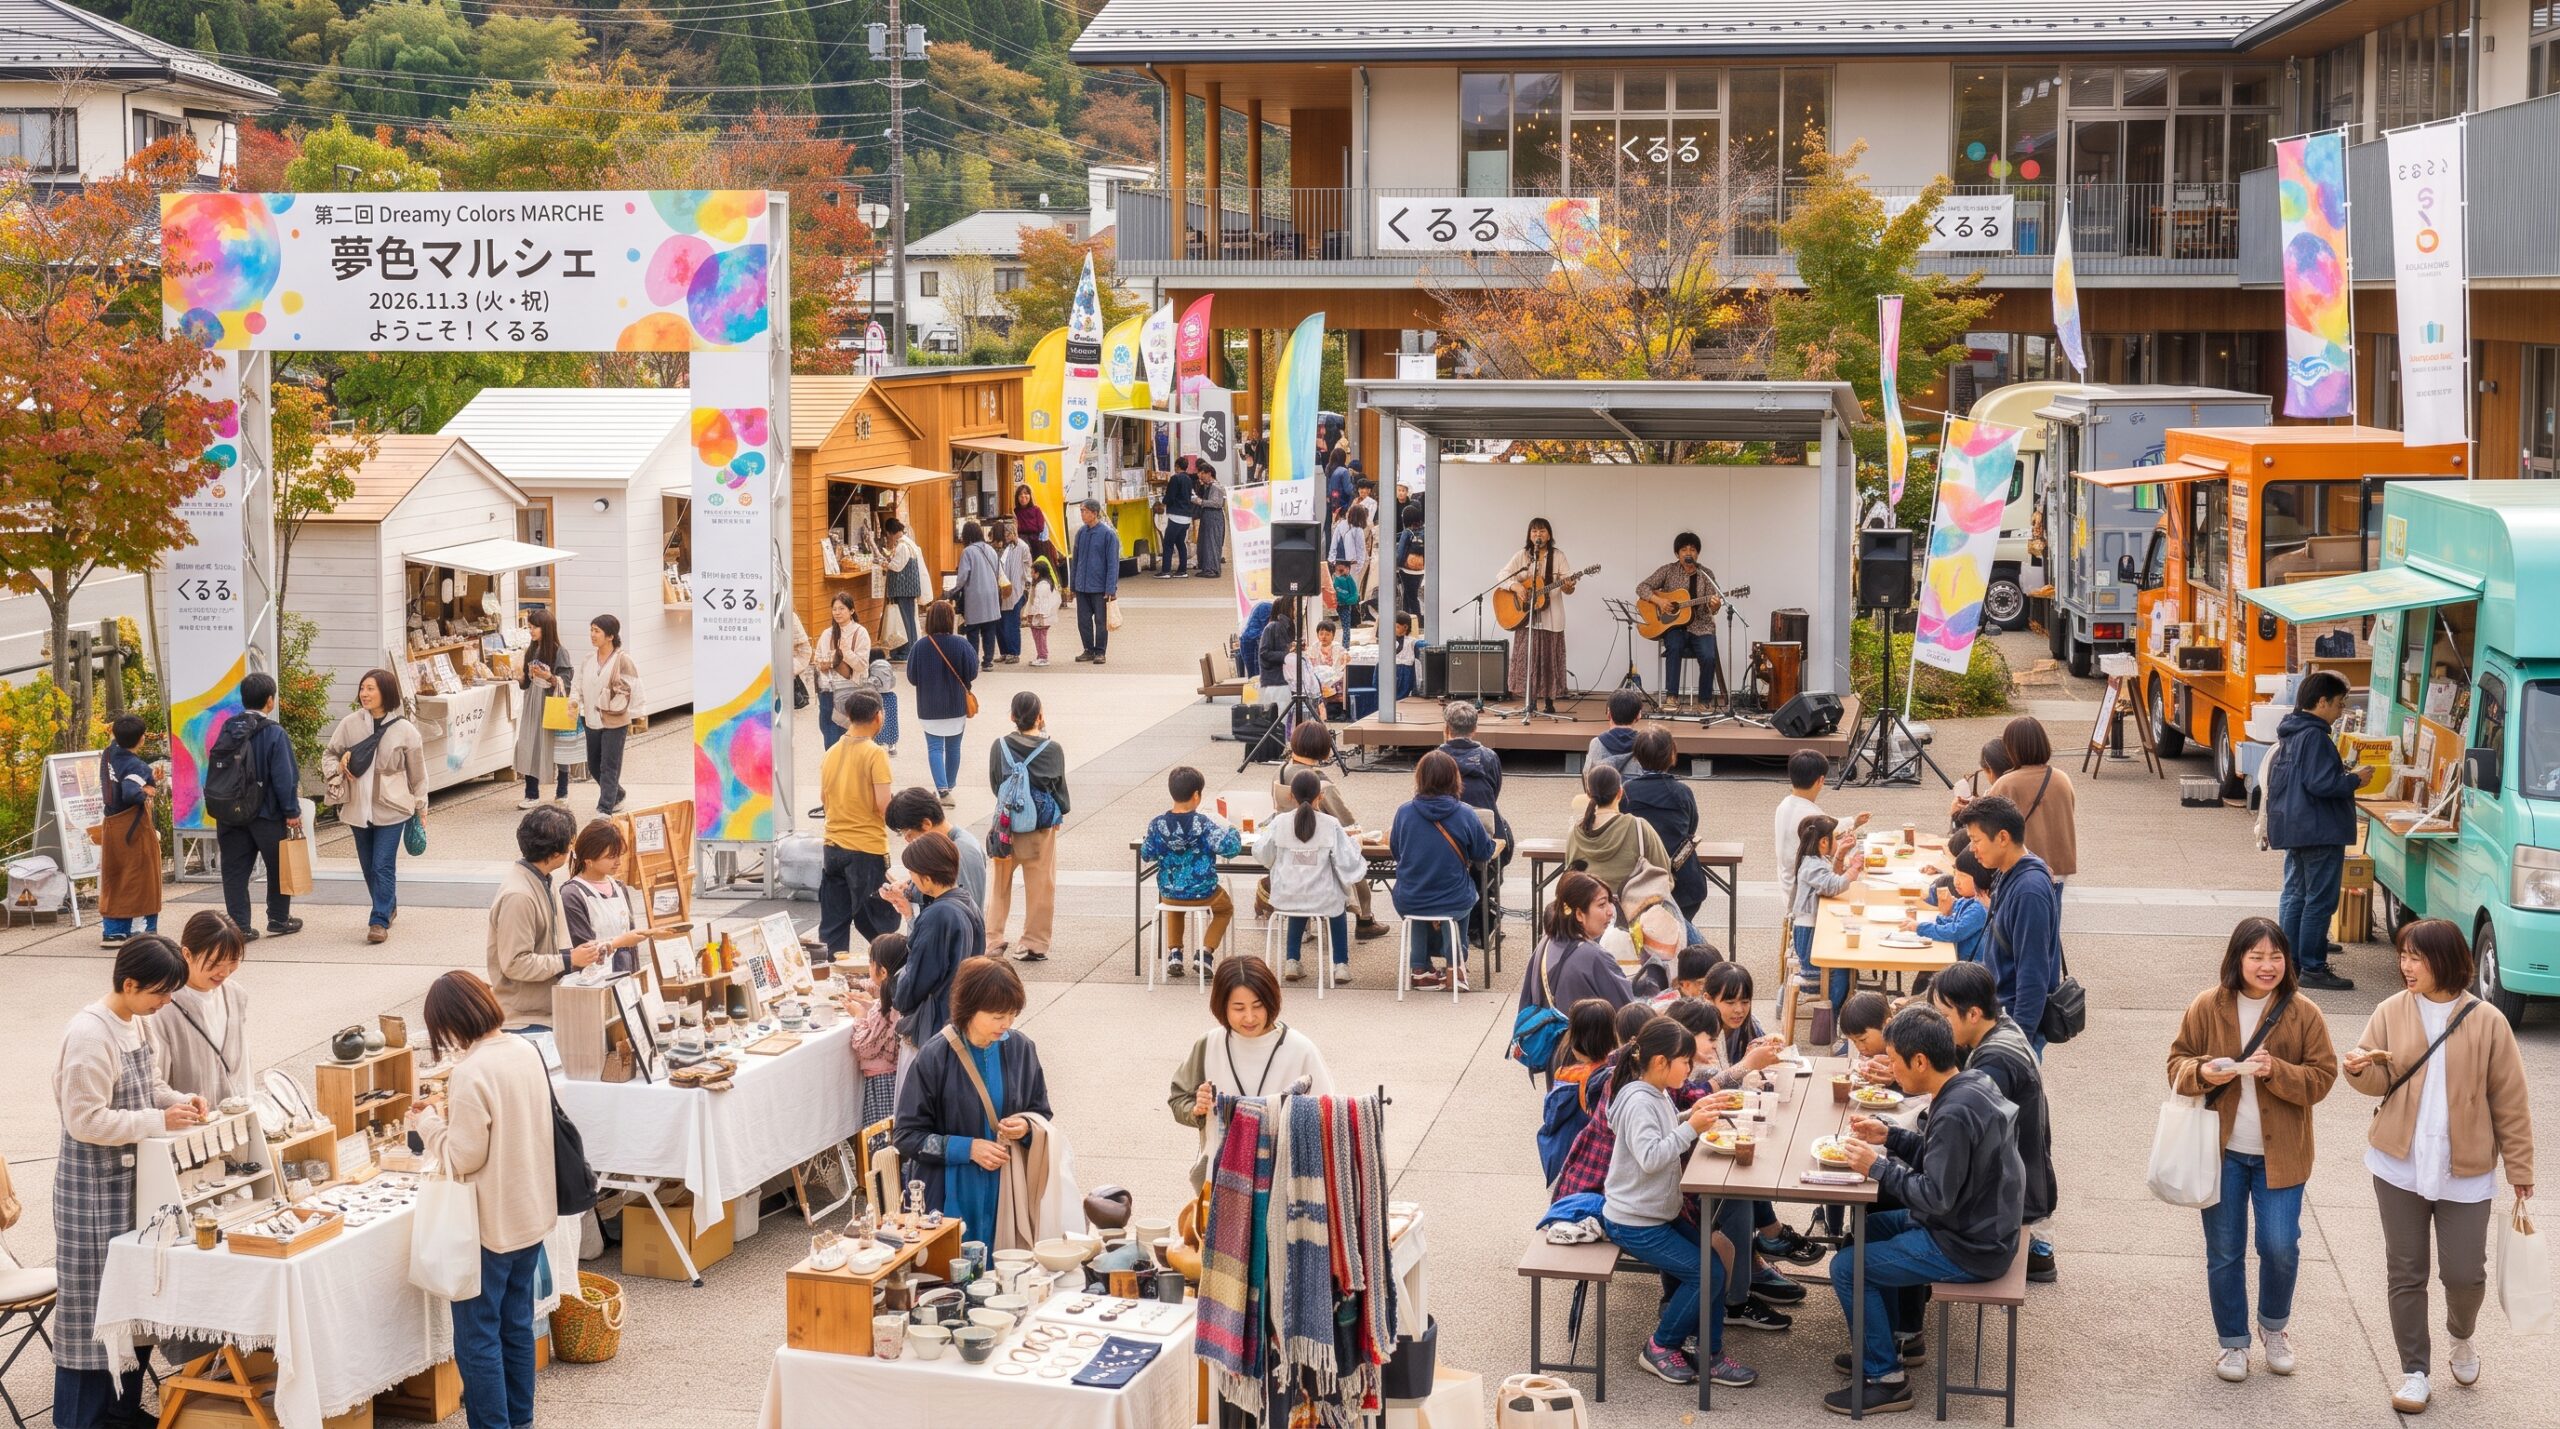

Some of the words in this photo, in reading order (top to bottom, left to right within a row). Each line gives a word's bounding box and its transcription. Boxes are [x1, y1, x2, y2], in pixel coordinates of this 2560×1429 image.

[1621, 136, 1700, 163] くるる
[314, 204, 374, 225] 第二回
[380, 205, 451, 226] Dreamy
[457, 204, 516, 222] Colors
[522, 204, 604, 222] MARCHE
[1388, 206, 1500, 243] くるる
[1933, 216, 1999, 238] くるる
[330, 235, 596, 281] 夢色マルシェ
[369, 291, 468, 310] 2026.11.3
[476, 290, 549, 312] (火・祝)
[369, 319, 549, 342] ようこそ！くるる
[178, 578, 231, 601] くるる
[702, 587, 758, 611] くるる
